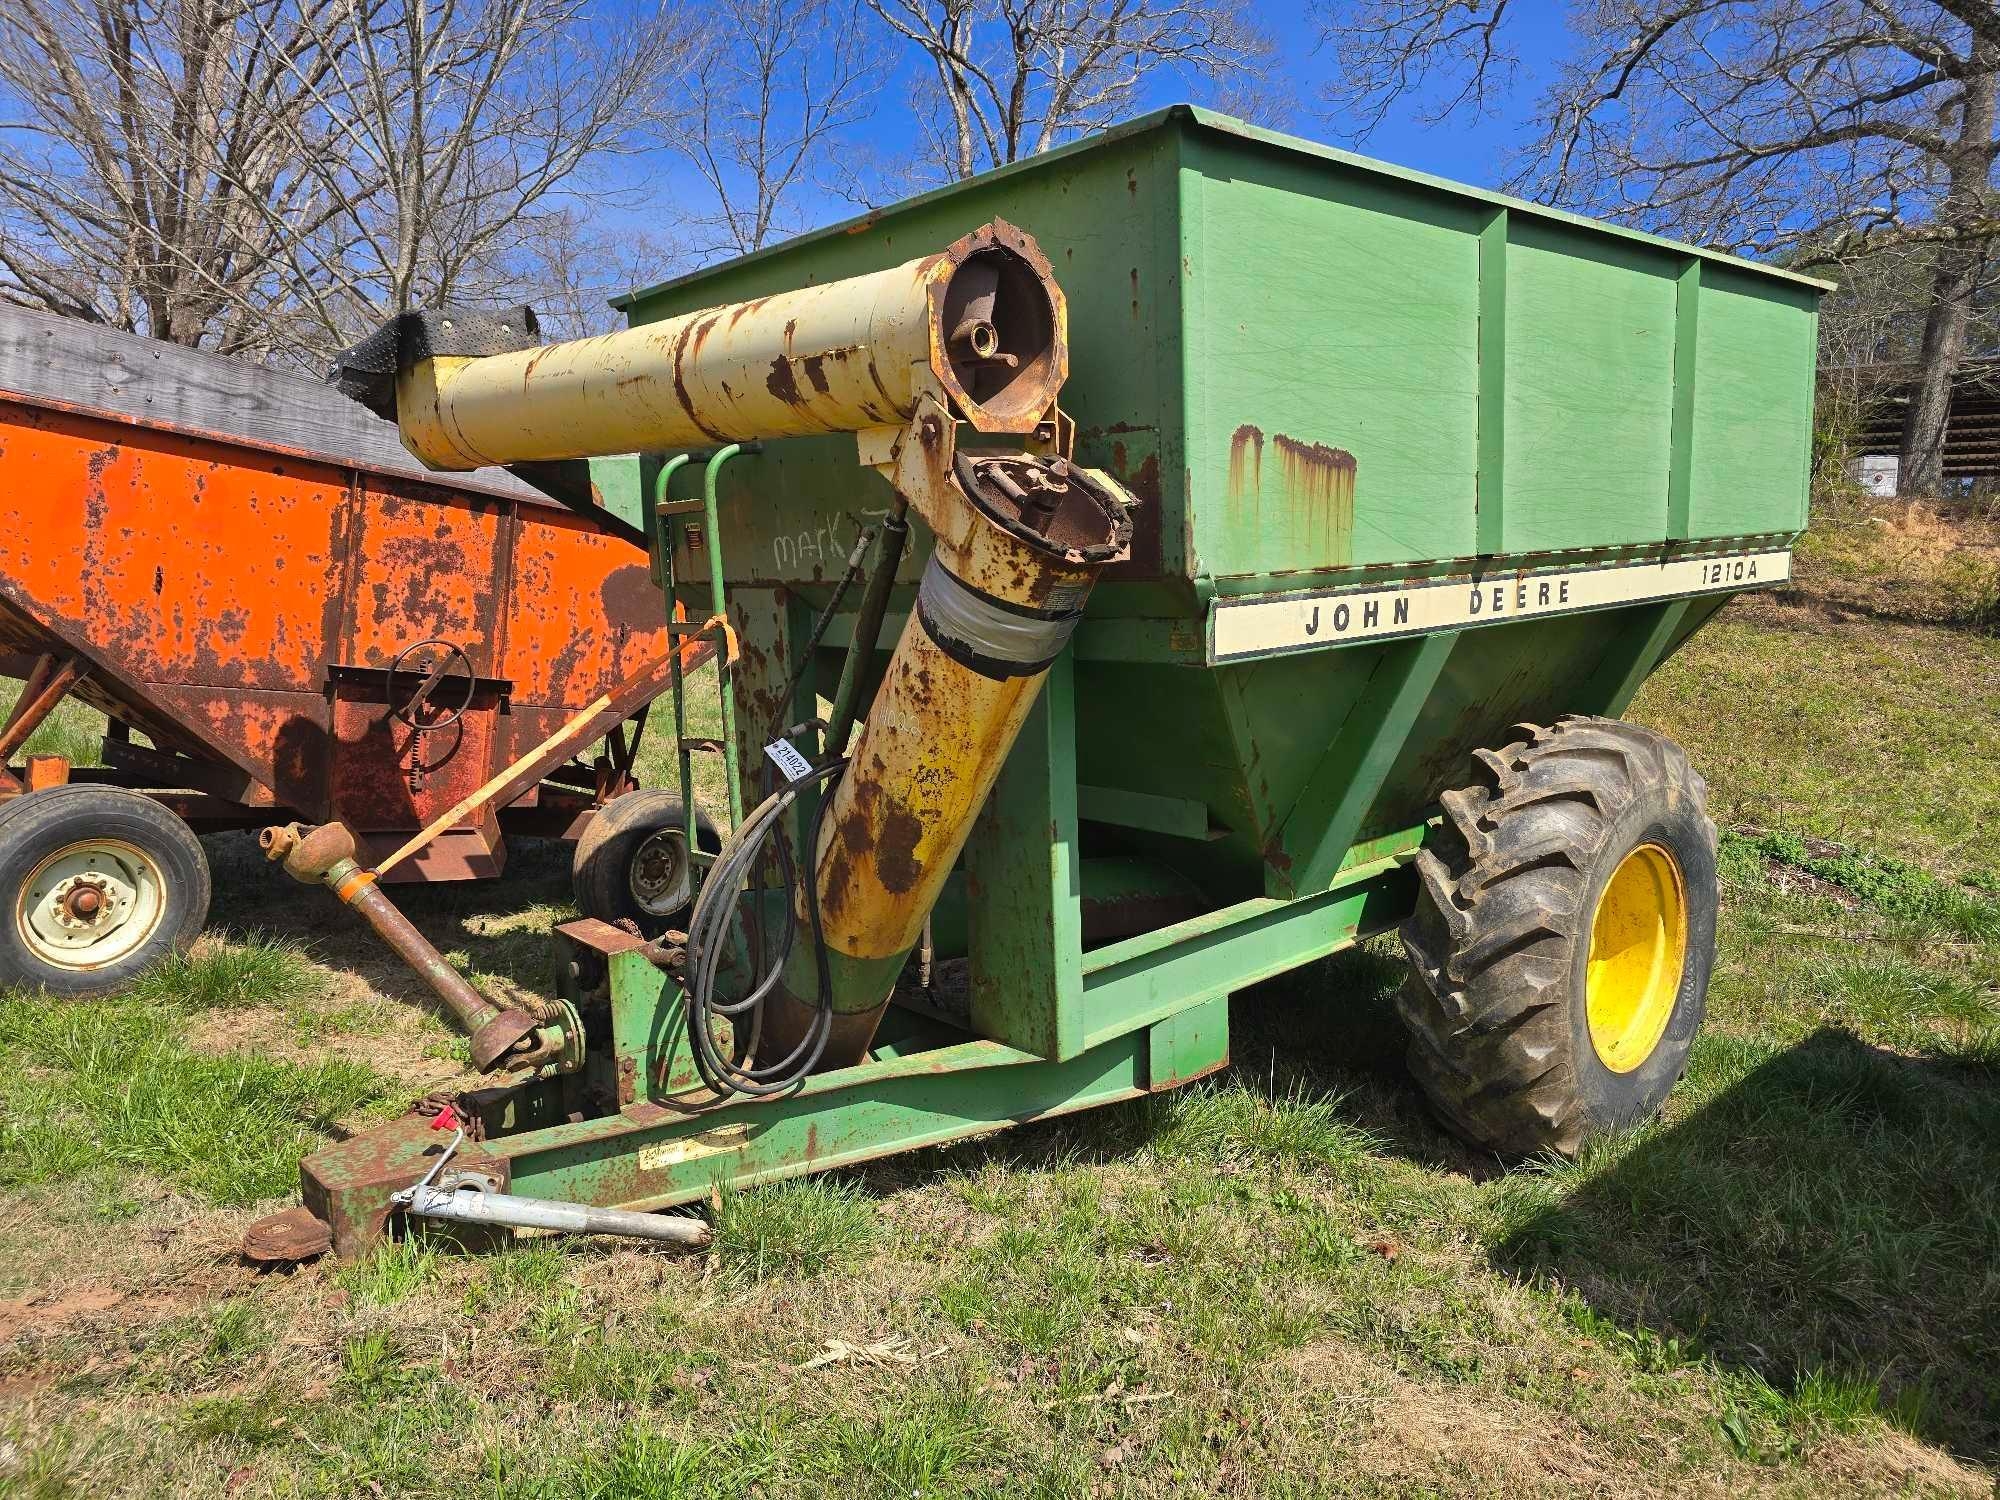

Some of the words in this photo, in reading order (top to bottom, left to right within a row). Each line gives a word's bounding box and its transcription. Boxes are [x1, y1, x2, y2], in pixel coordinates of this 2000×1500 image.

[1305, 597, 1409, 636] JOHN
[1470, 580, 1569, 615] DEERE
[1702, 560, 1757, 584] 1210A
[777, 746, 807, 775] 214022
